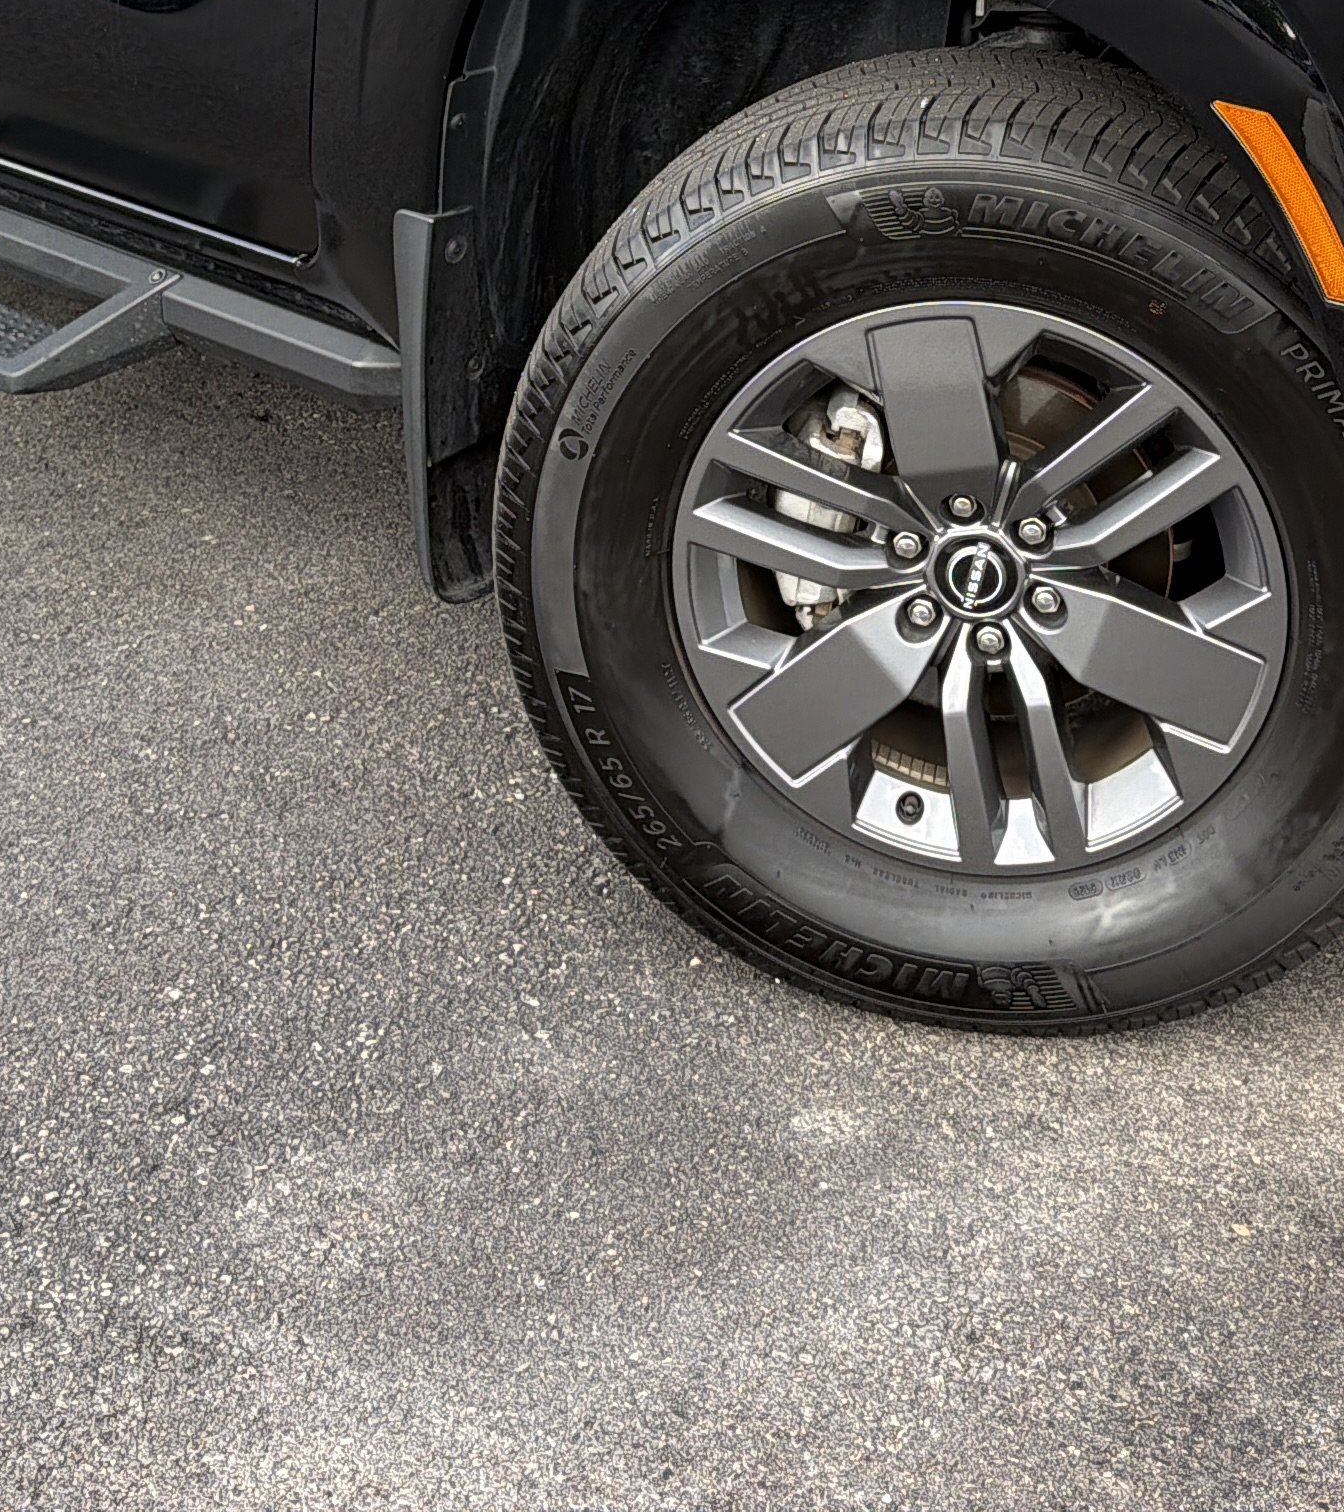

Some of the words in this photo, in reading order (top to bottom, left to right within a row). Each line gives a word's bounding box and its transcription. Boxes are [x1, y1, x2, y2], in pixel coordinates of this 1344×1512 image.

[967, 192, 1250, 321] MICHELIN
[572, 360, 611, 426] MICHELIN
[581, 406, 600, 436] Total
[593, 349, 637, 412] Performance
[963, 542, 992, 611] NISSAN
[568, 687, 596, 714] 17
[584, 729, 612, 746] R
[602, 757, 684, 851] 265/65
[701, 872, 970, 998] MICHELIN
